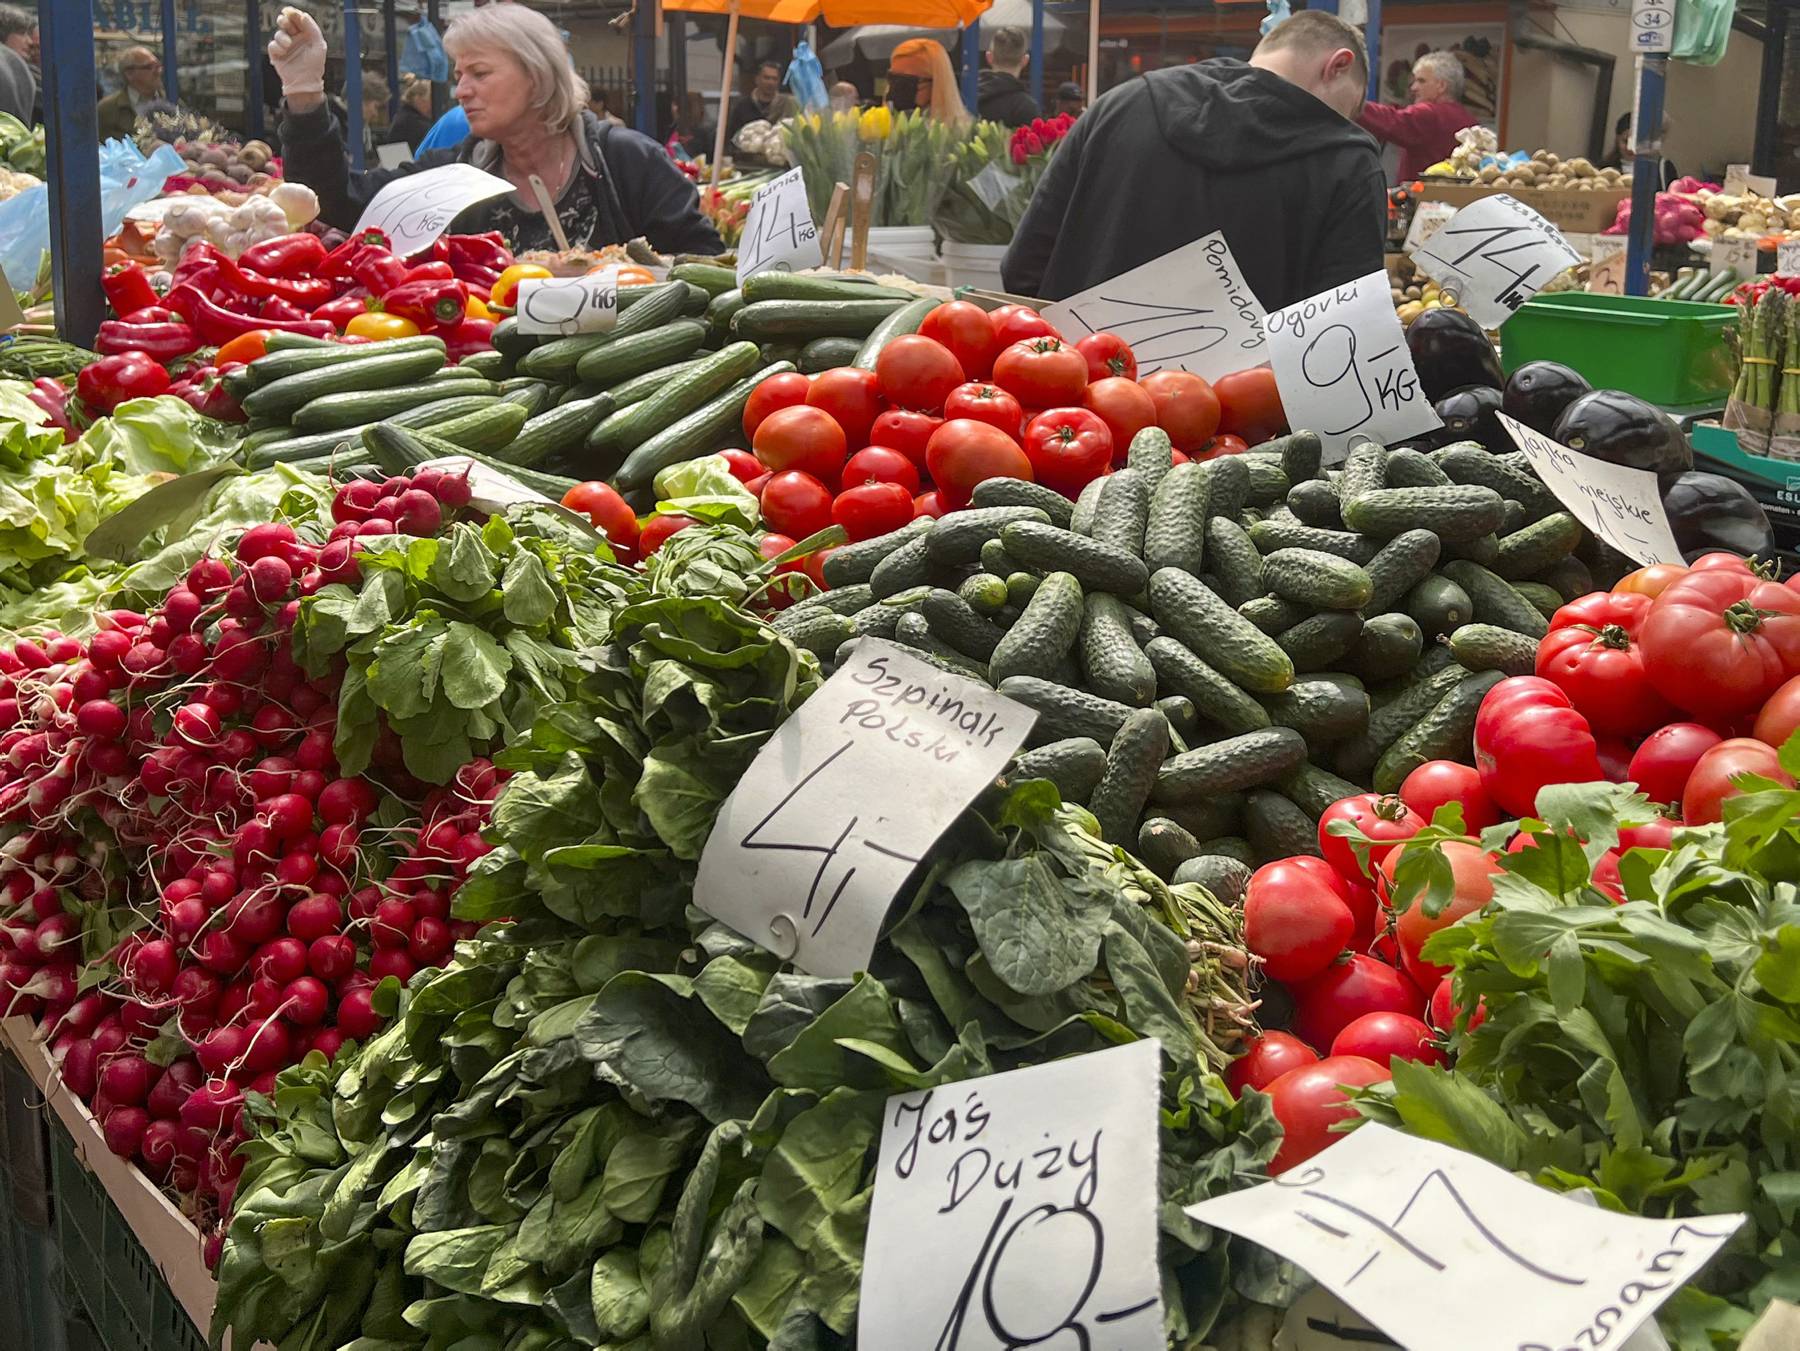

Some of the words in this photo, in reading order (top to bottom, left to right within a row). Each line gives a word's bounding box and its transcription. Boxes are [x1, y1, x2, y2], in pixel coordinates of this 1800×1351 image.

[1375, 369, 1417, 411] KG
[851, 657, 1004, 748] Szpinak
[895, 1090, 991, 1180] Jaś
[938, 1129, 1103, 1214] Duży
